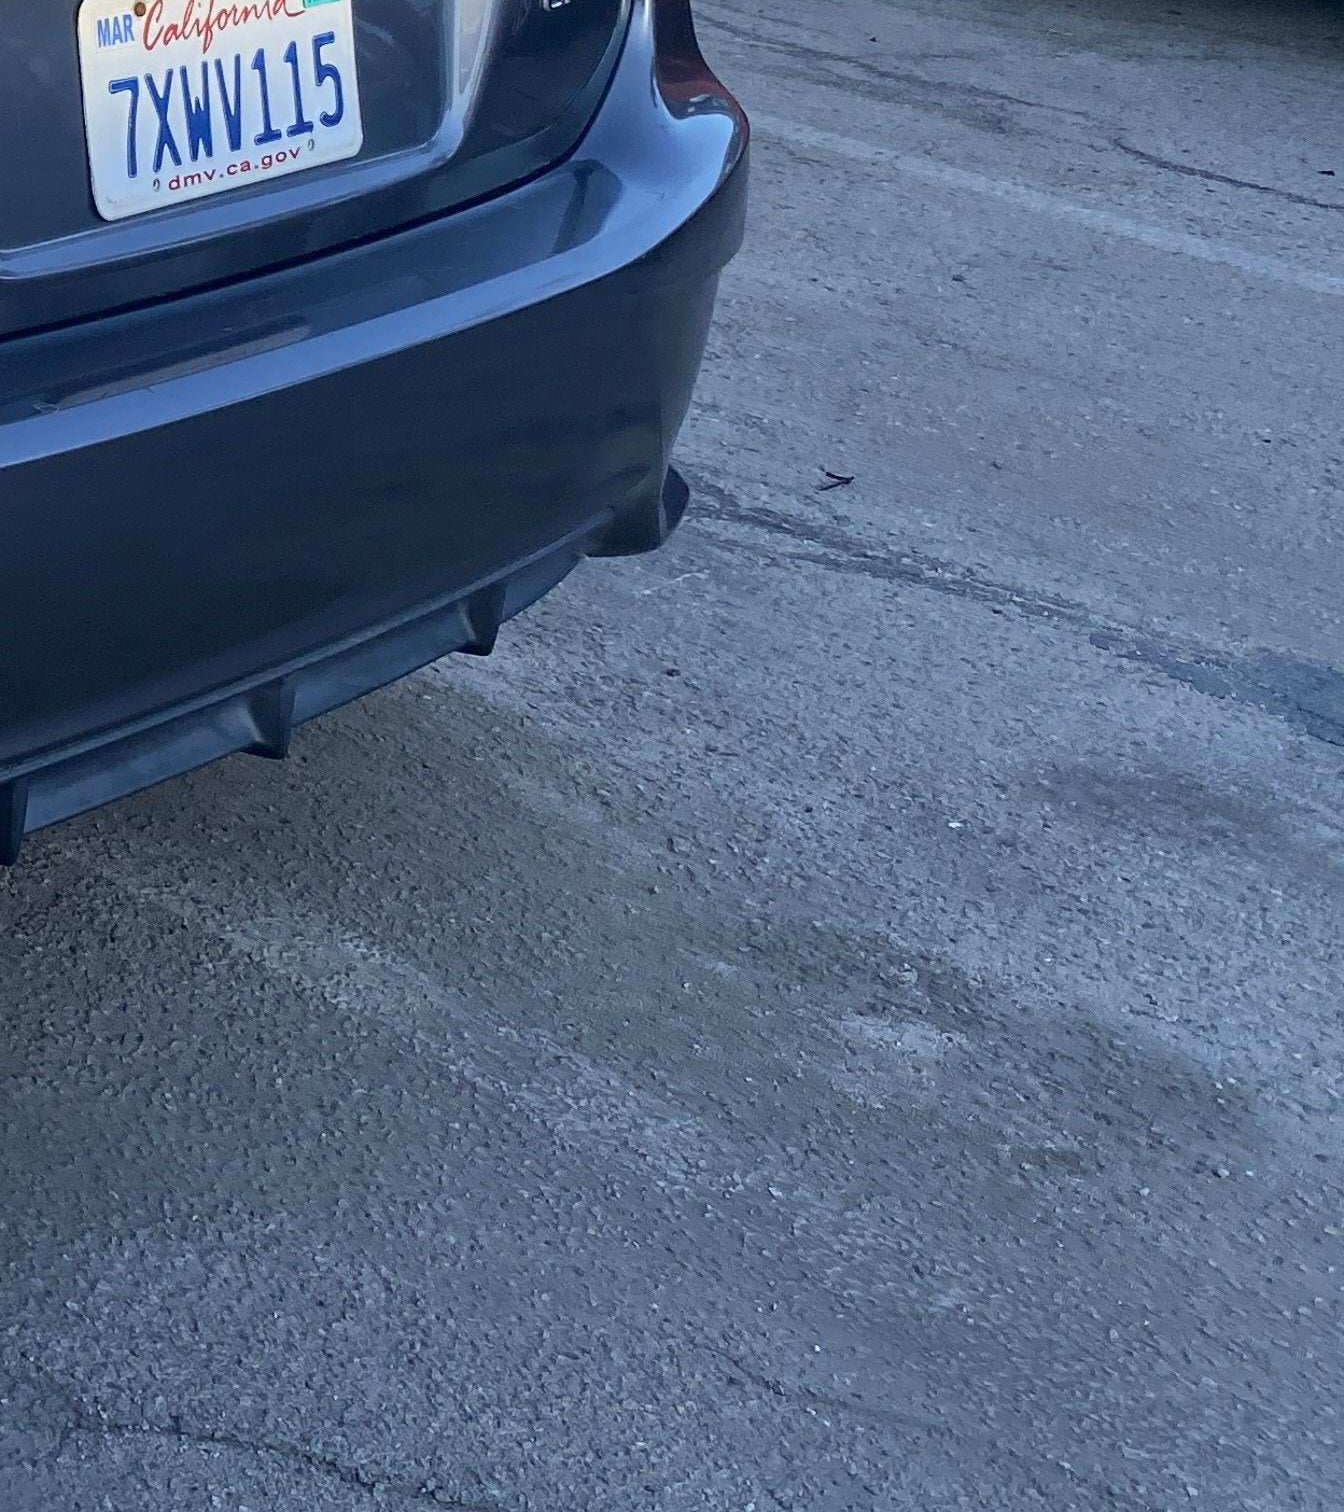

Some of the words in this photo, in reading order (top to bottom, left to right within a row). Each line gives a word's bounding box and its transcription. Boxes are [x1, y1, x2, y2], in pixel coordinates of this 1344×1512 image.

[97, 13, 135, 47] MAR
[108, 31, 344, 178] 7XWV115
[168, 147, 302, 191] dmv.ca.gov
